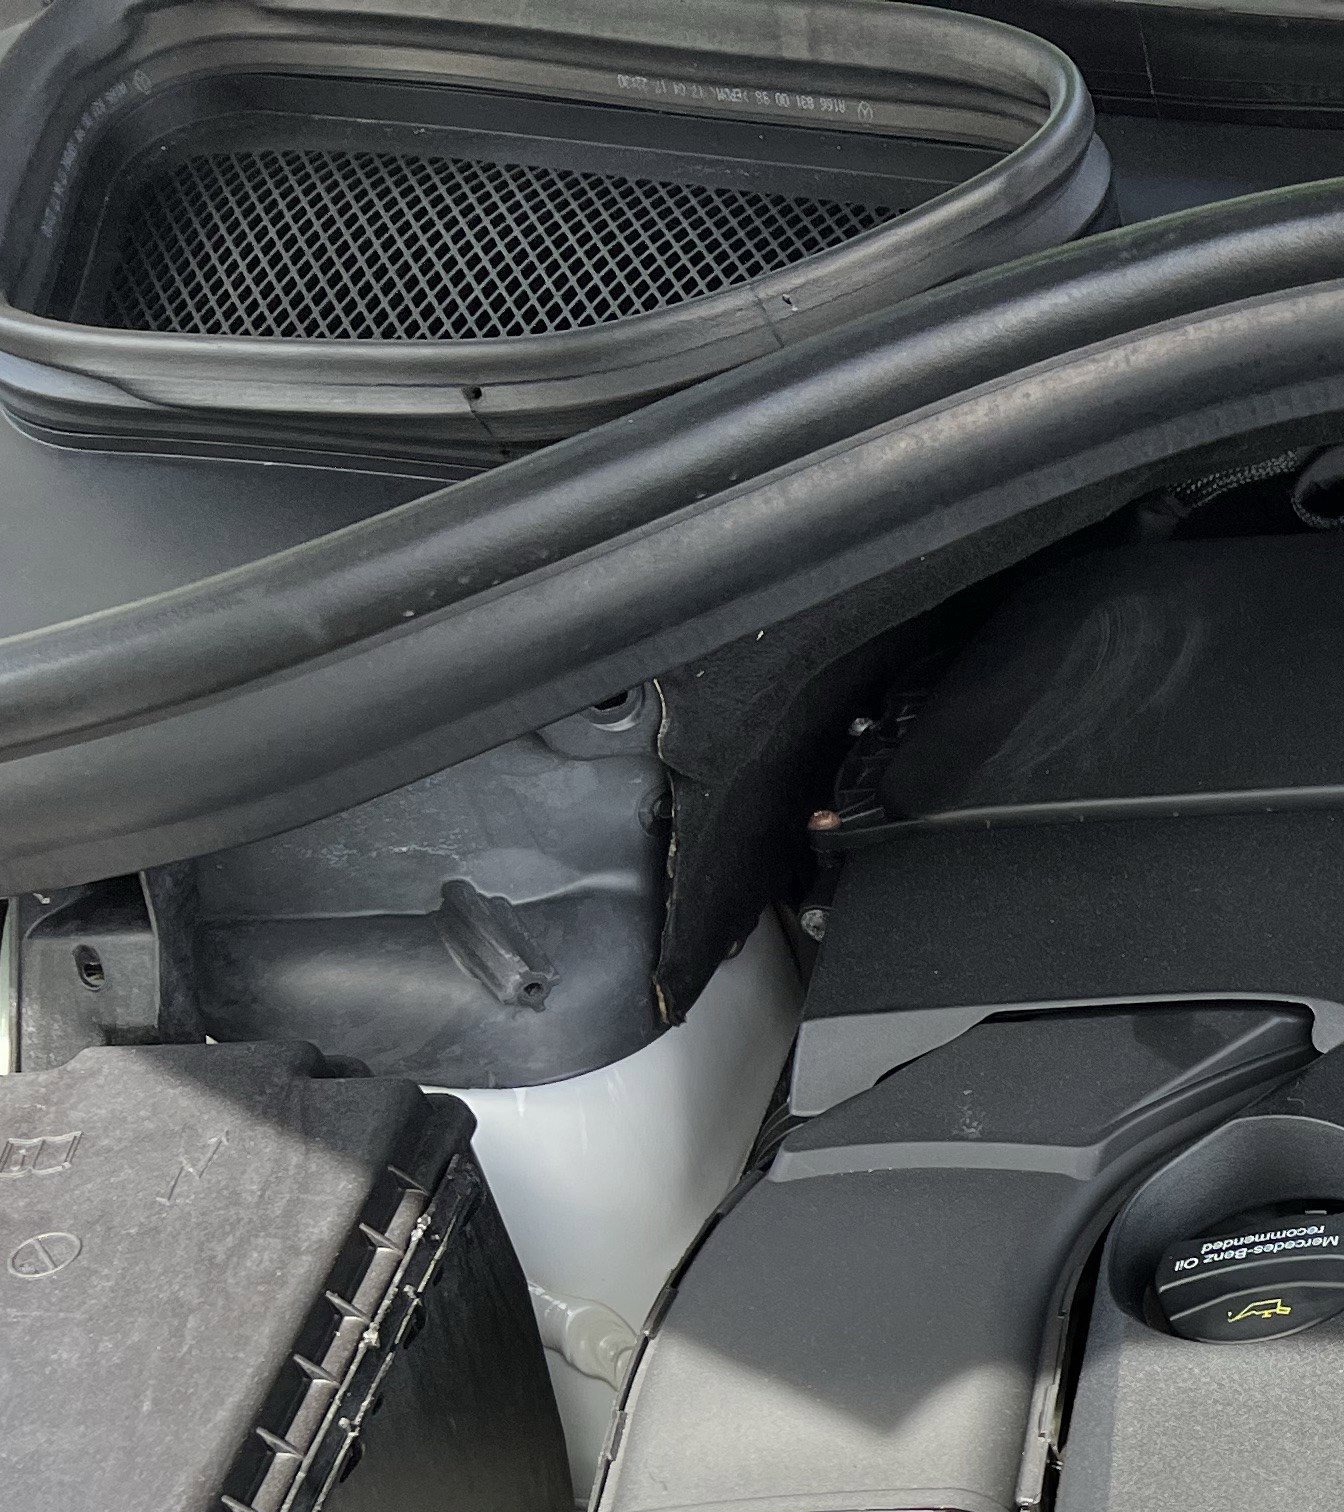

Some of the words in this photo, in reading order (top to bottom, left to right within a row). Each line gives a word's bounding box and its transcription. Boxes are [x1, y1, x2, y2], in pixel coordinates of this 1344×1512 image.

[1201, 1225, 1325, 1255] recommended
[1203, 1235, 1340, 1265] Mercedes-Benz
[1174, 1256, 1200, 1272] Oil
